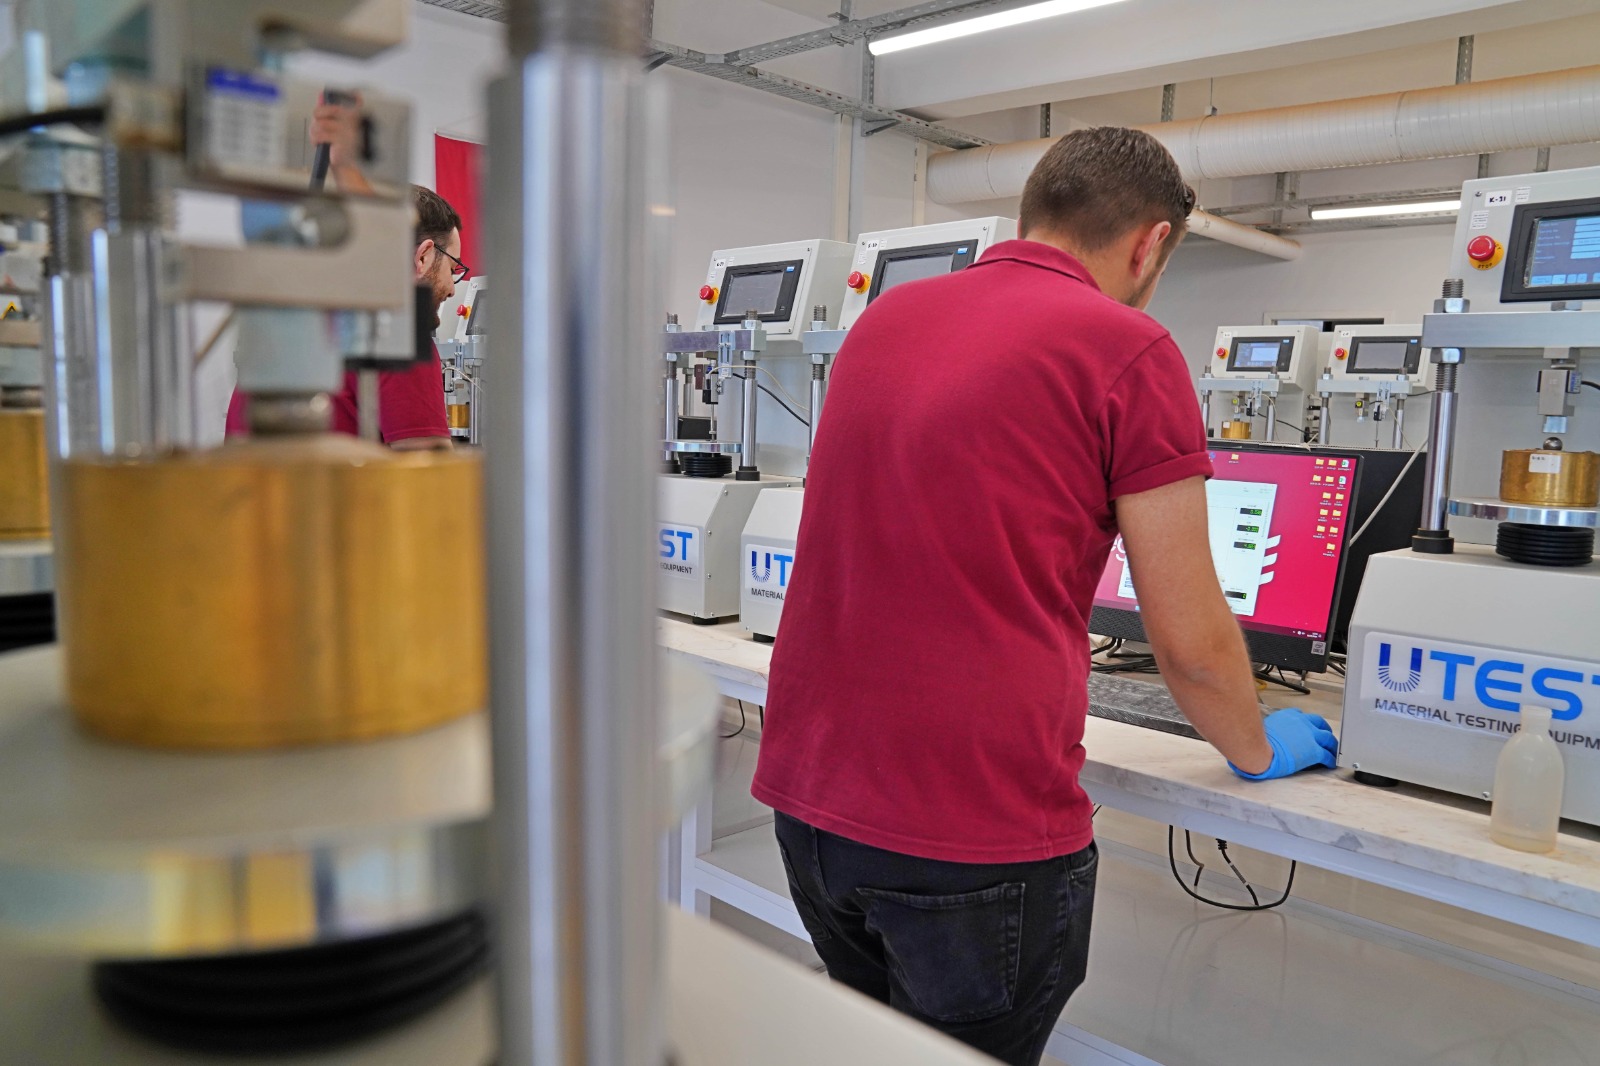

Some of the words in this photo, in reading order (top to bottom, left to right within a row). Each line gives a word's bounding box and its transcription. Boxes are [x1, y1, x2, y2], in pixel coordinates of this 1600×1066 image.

[658, 528, 693, 561] ST
[751, 550, 793, 587] UT
[751, 587, 785, 601] MATERIAL
[1378, 642, 1600, 722] UTES
[1374, 698, 1452, 723] MATERIAL
